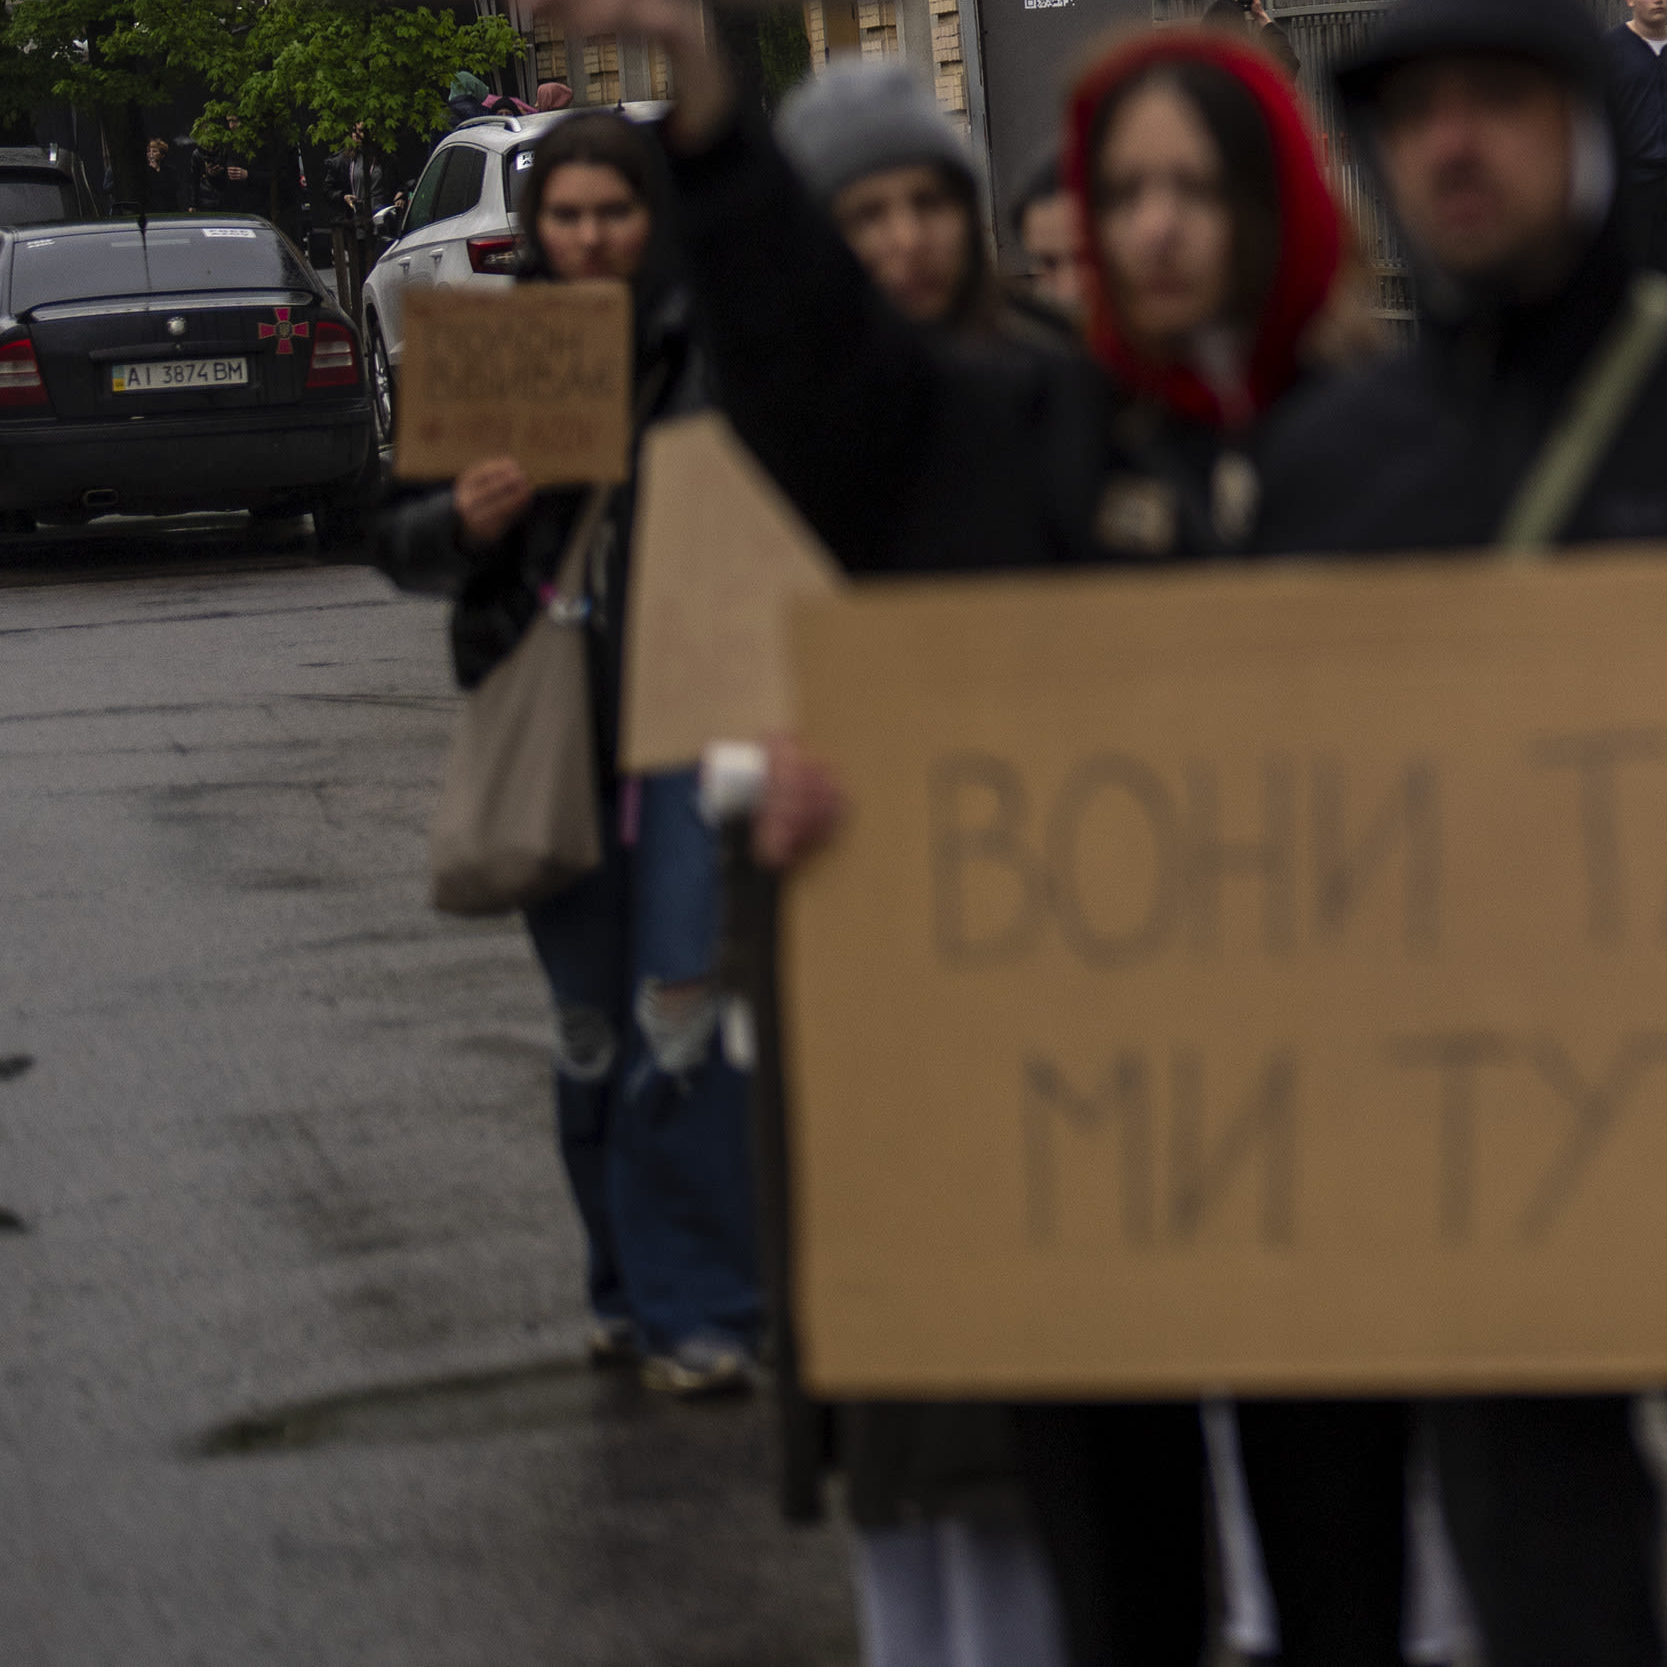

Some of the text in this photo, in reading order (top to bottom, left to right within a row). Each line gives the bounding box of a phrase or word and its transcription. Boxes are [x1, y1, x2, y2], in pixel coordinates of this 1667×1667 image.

[127, 367, 151, 387] AI
[162, 363, 209, 384] 3874
[213, 362, 244, 382] BM
[928, 745, 1445, 973] ВОНИ
[1020, 1043, 1300, 1253] МИ
